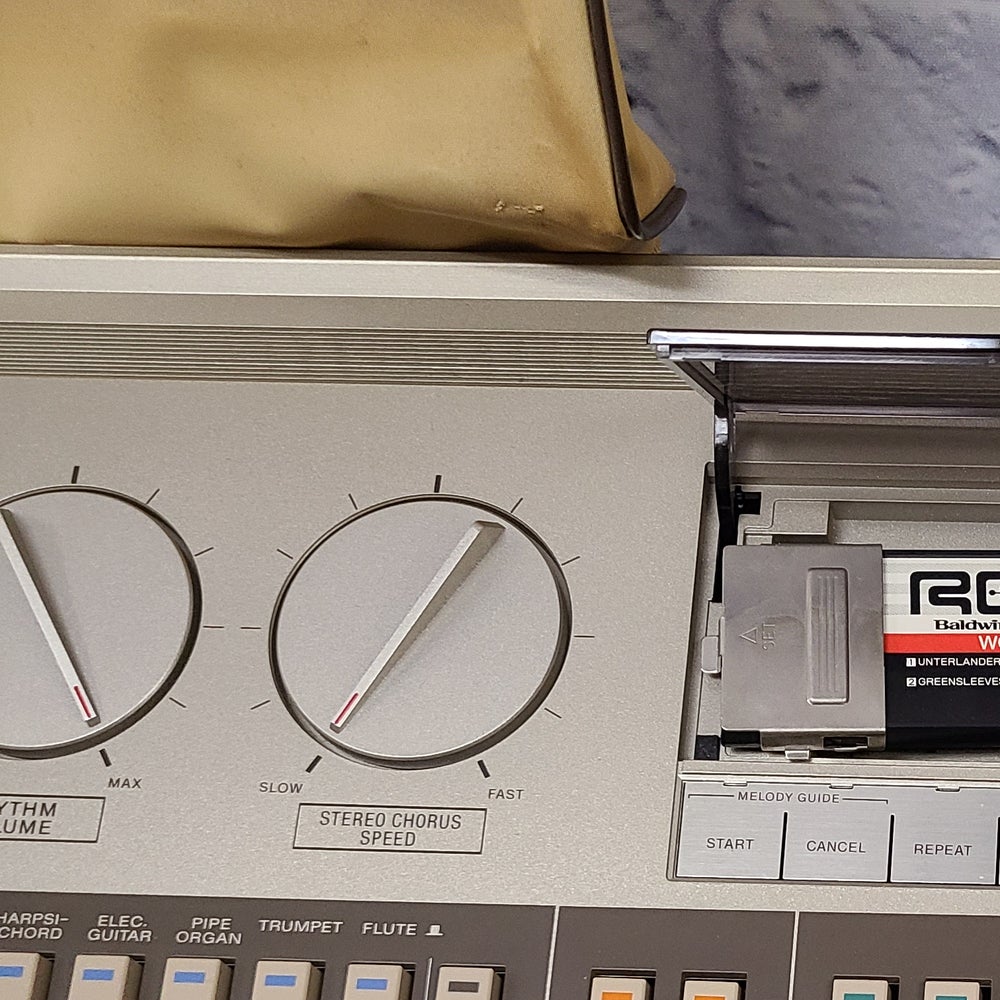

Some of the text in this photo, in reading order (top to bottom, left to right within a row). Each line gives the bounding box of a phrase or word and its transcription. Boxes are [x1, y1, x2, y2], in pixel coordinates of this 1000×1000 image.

[107, 777, 142, 789] MAX
[259, 781, 304, 794] SLOW
[488, 788, 525, 800] FAST
[737, 791, 840, 804] MELODY GUIDE
[0, 818, 53, 835] UME
[319, 810, 462, 830] STEREO CHORUS
[360, 830, 416, 847] SPEED
[706, 837, 754, 850] START
[806, 840, 866, 854] CANCEL
[914, 843, 973, 856] REPEAT
[97, 914, 148, 928] ELEC.
[191, 917, 232, 930] PIPE
[258, 919, 344, 933] TRUMPET
[0, 926, 63, 940] CHORD
[87, 928, 152, 942] GUITAR
[362, 922, 418, 936] FLUTE
[175, 930, 242, 945] ORGAN
